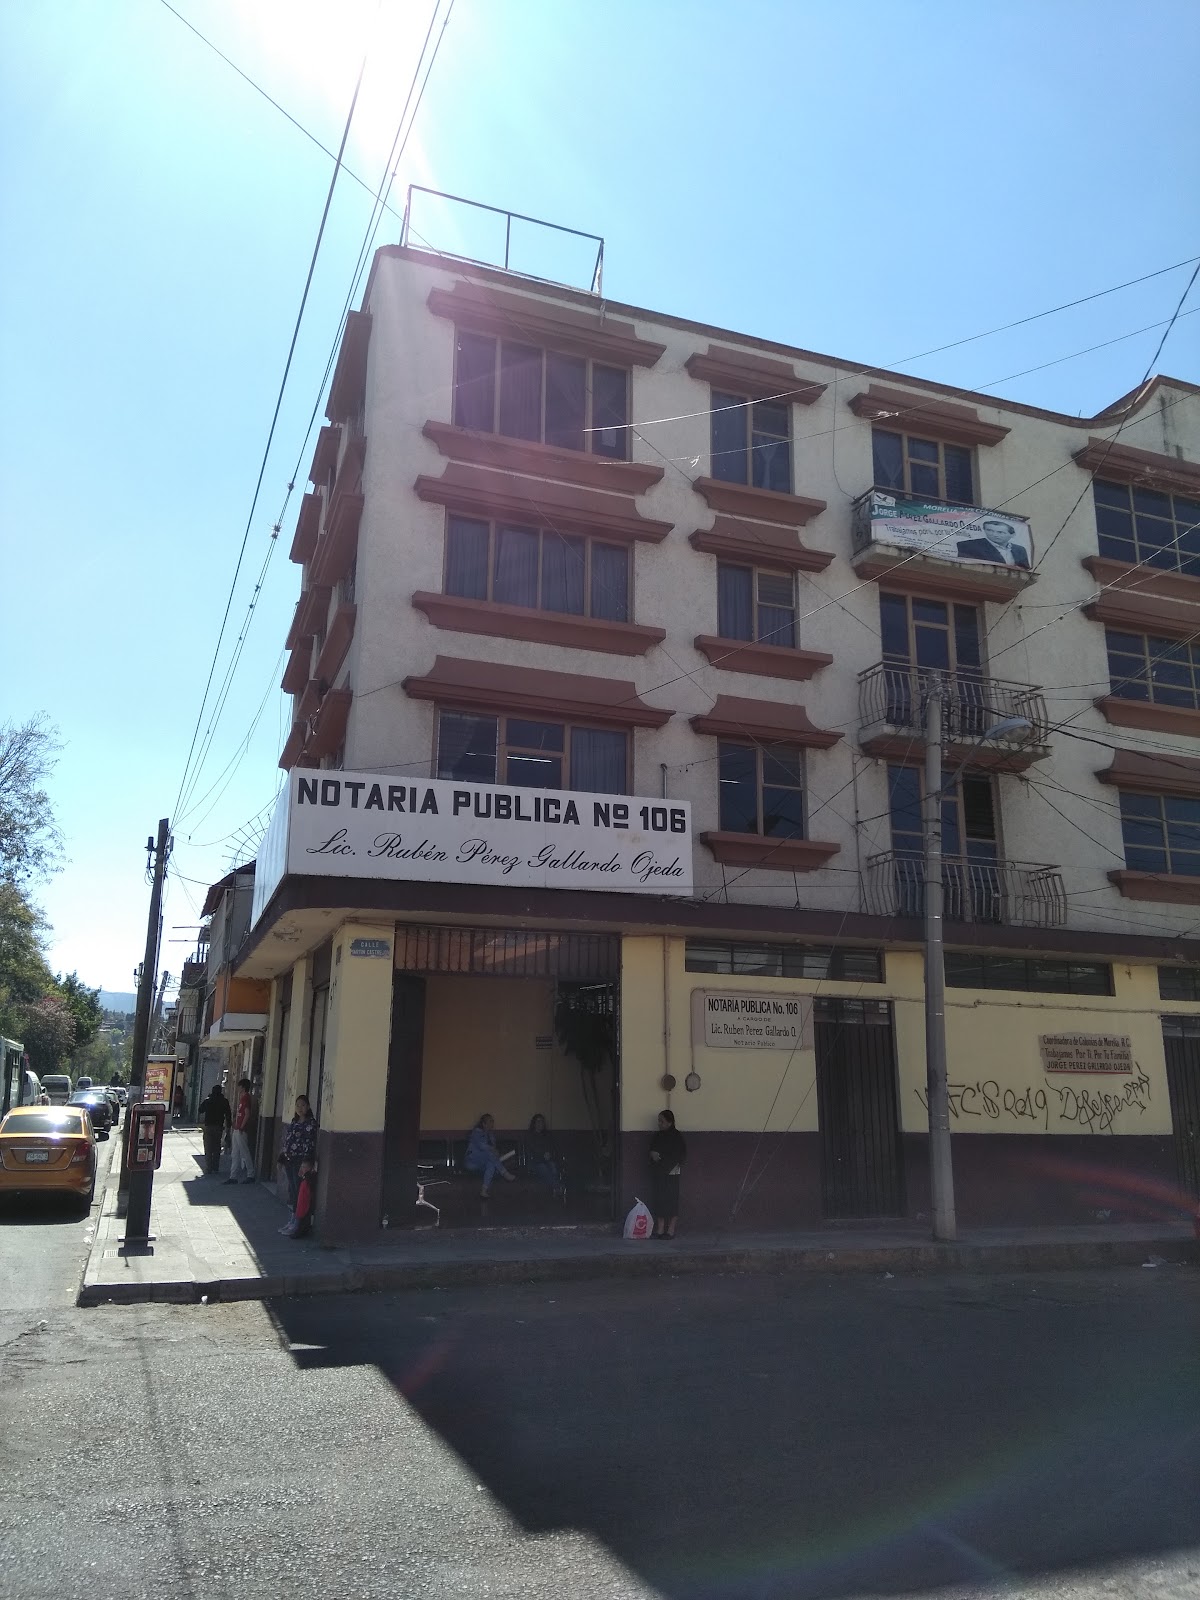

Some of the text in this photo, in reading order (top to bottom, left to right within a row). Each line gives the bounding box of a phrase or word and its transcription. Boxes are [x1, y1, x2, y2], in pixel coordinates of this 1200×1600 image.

[872, 505, 897, 518] JORGE
[298, 778, 439, 814] NOTARIA
[453, 790, 581, 825] PUBLICA
[640, 806, 686, 833] 106
[306, 828, 685, 883] Lic. Rubén Pérez Gallardo Ojeda
[772, 1001, 785, 1015] No.
[785, 1002, 799, 1015] 106
[723, 1023, 745, 1035] Ruben
[745, 1025, 763, 1036] Perez
[765, 1025, 789, 1037] Gallardo
[1046, 1061, 1067, 1069] JORGE
[1068, 1061, 1086, 1070] PEREZ
[1113, 1062, 1131, 1071] OJEDA
